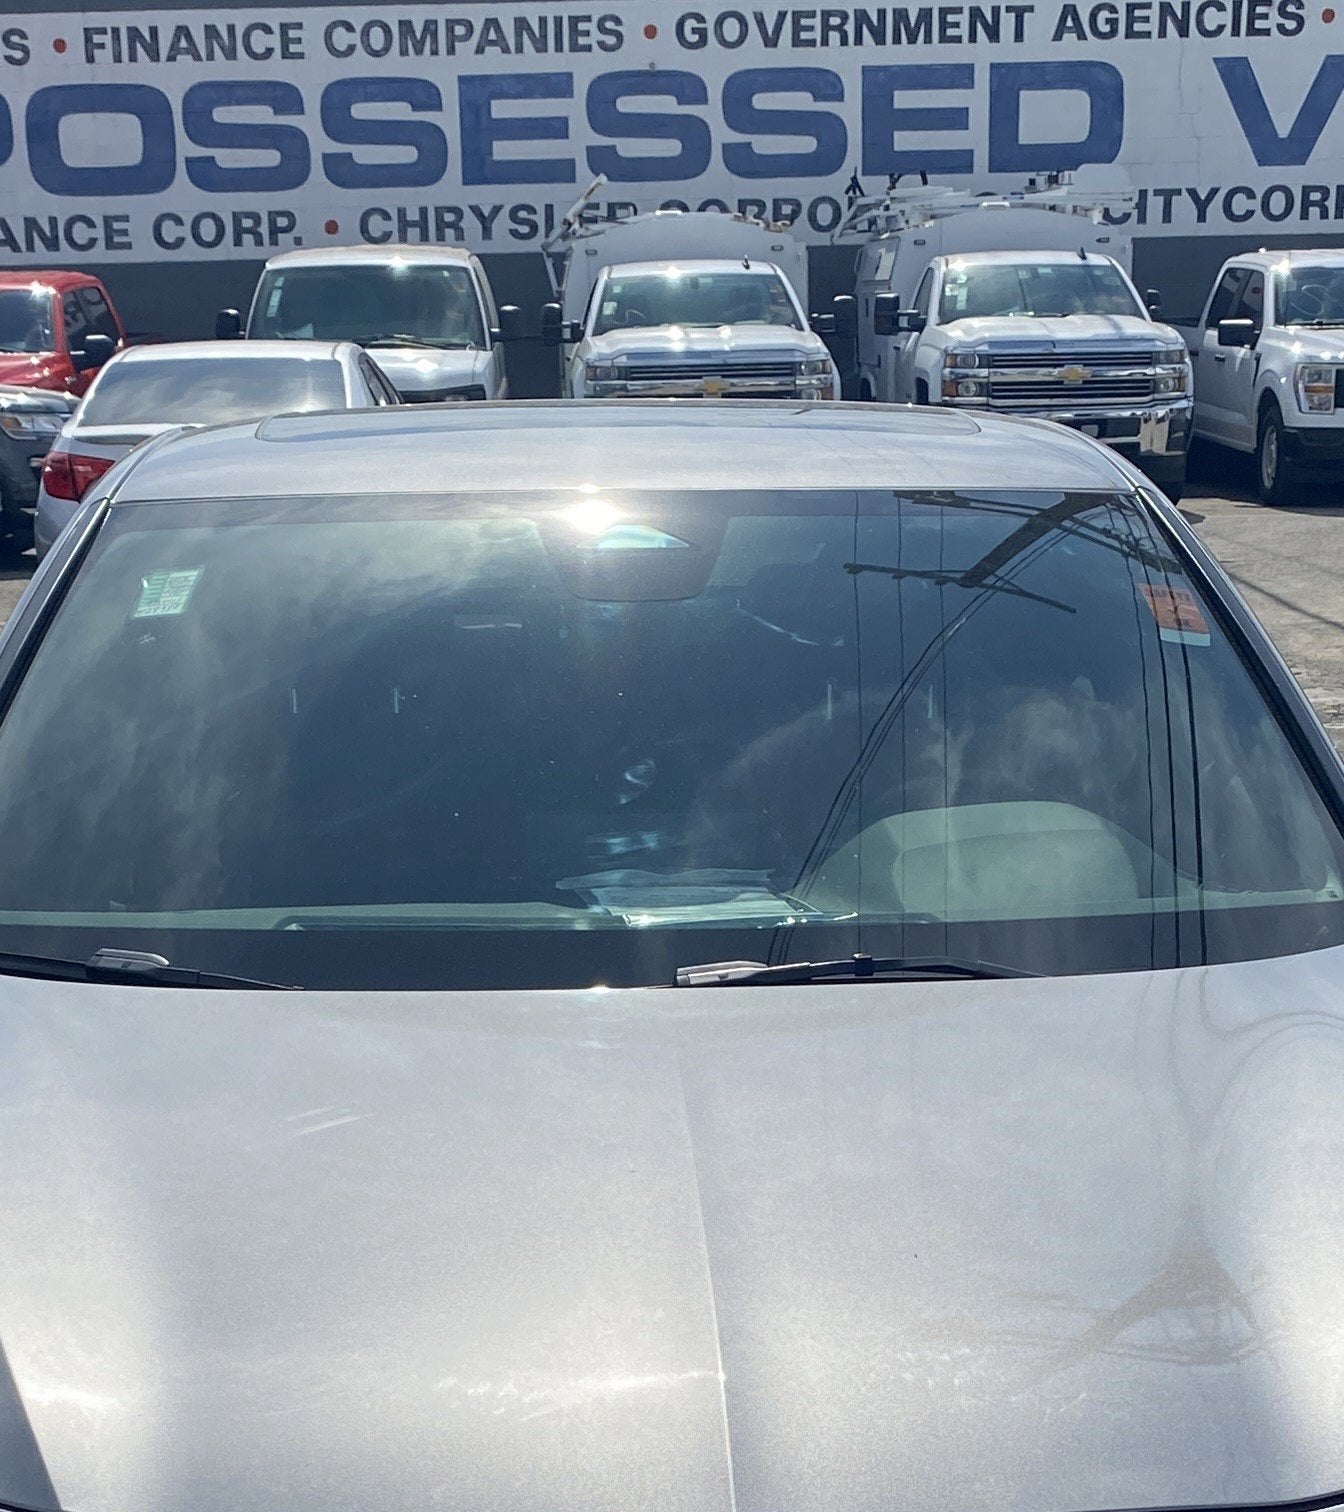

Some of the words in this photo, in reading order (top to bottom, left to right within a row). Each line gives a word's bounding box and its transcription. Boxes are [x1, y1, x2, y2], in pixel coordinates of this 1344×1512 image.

[83, 22, 306, 64] FINANCE
[324, 14, 624, 59] COMPANIES
[675, 4, 1035, 51] GOVERNMENT
[1052, 0, 1305, 42] AGENCIES
[152, 210, 303, 251] CORP.
